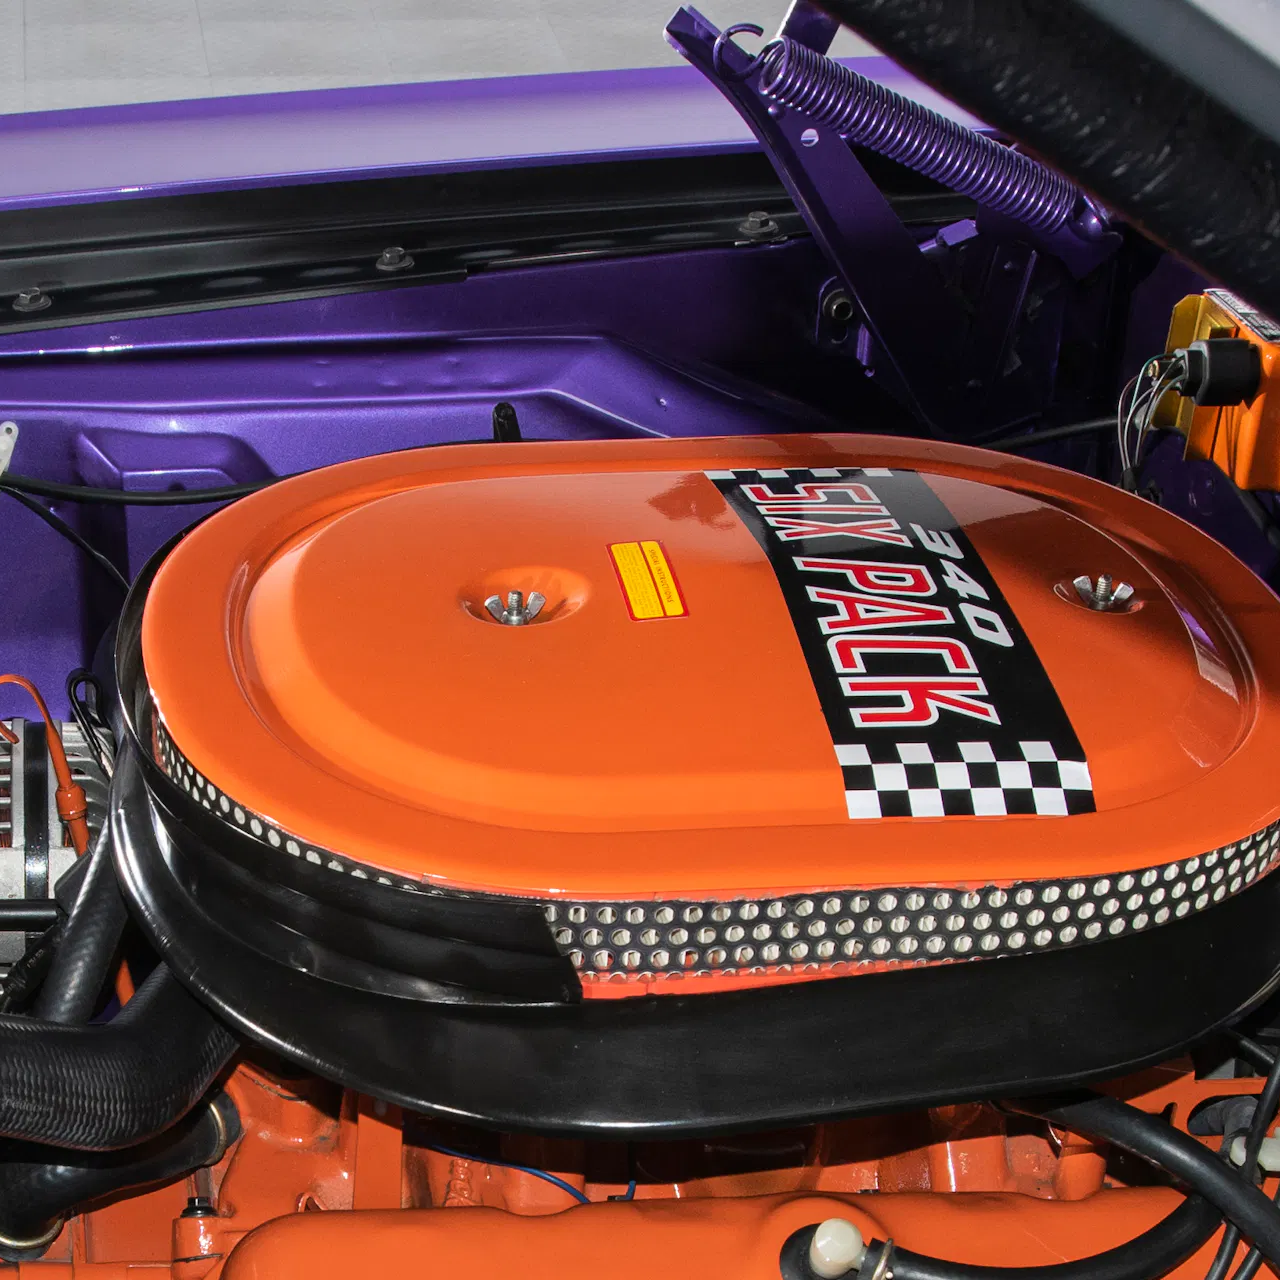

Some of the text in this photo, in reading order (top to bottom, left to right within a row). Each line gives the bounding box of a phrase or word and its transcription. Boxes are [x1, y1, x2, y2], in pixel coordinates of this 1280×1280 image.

[740, 482, 1002, 728] SIX PACK
[910, 522, 1014, 647] 340
